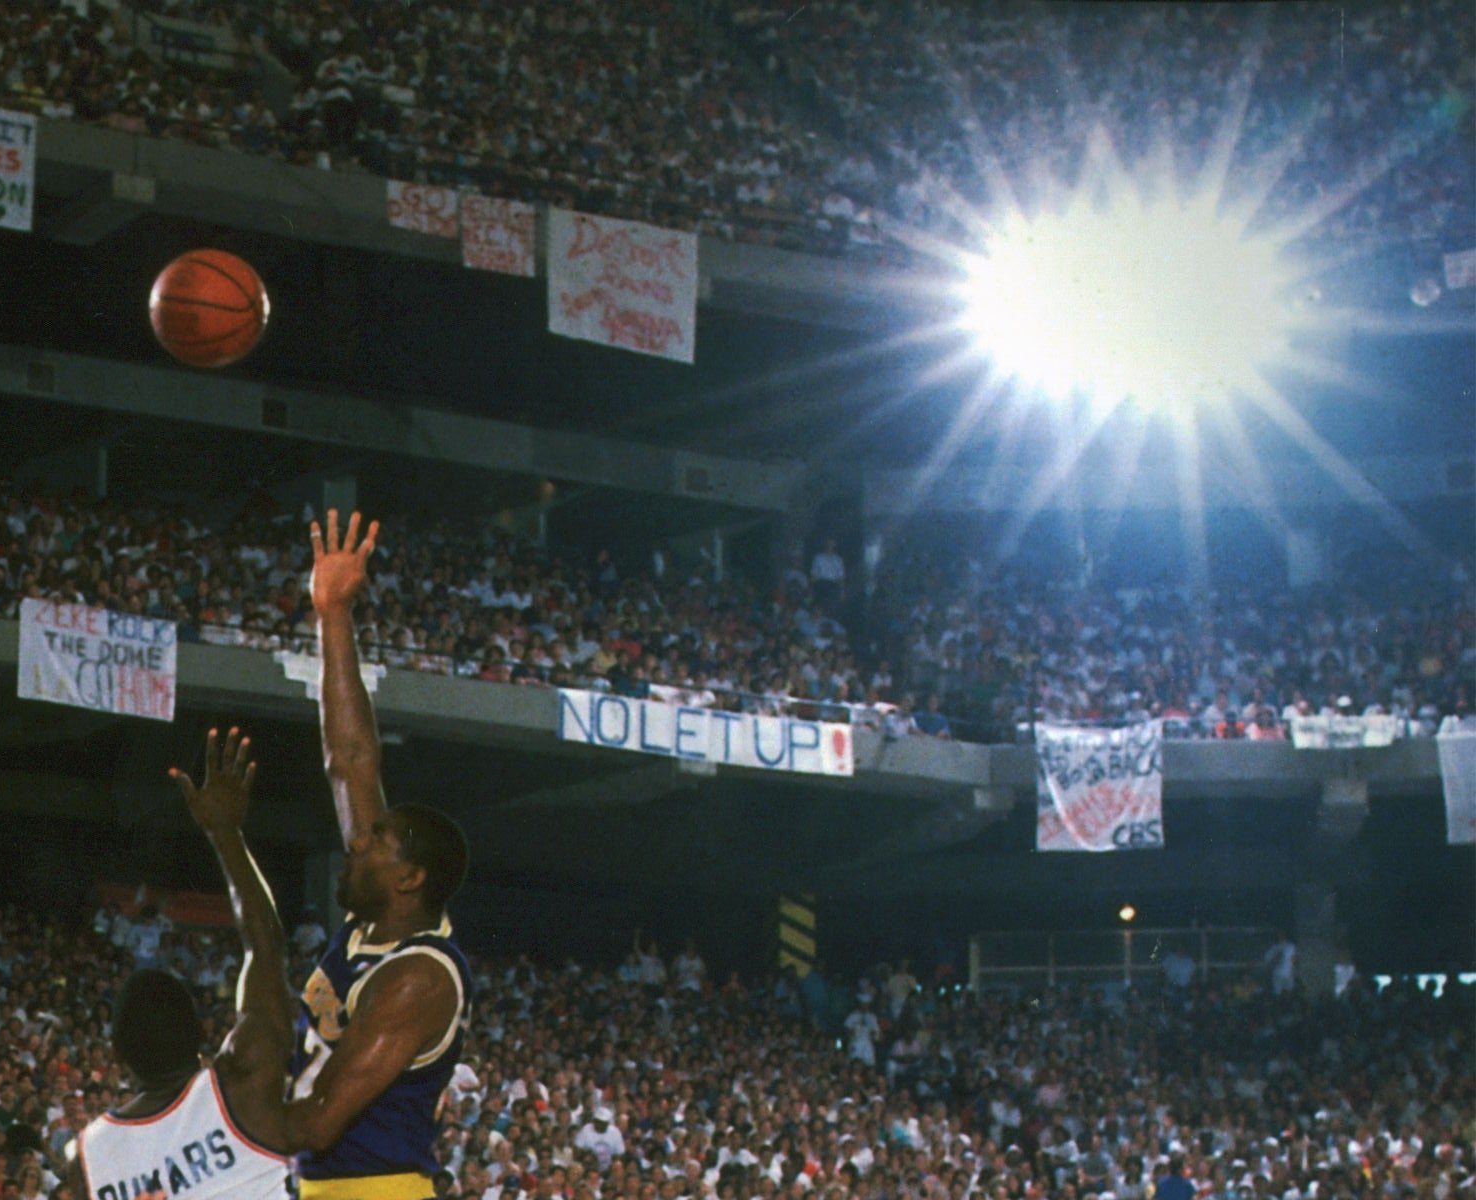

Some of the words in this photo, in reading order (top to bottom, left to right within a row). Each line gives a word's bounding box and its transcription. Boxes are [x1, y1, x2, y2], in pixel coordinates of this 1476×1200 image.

[43, 629, 87, 658] THE
[98, 640, 164, 671] DOME
[557, 693, 630, 746] NO
